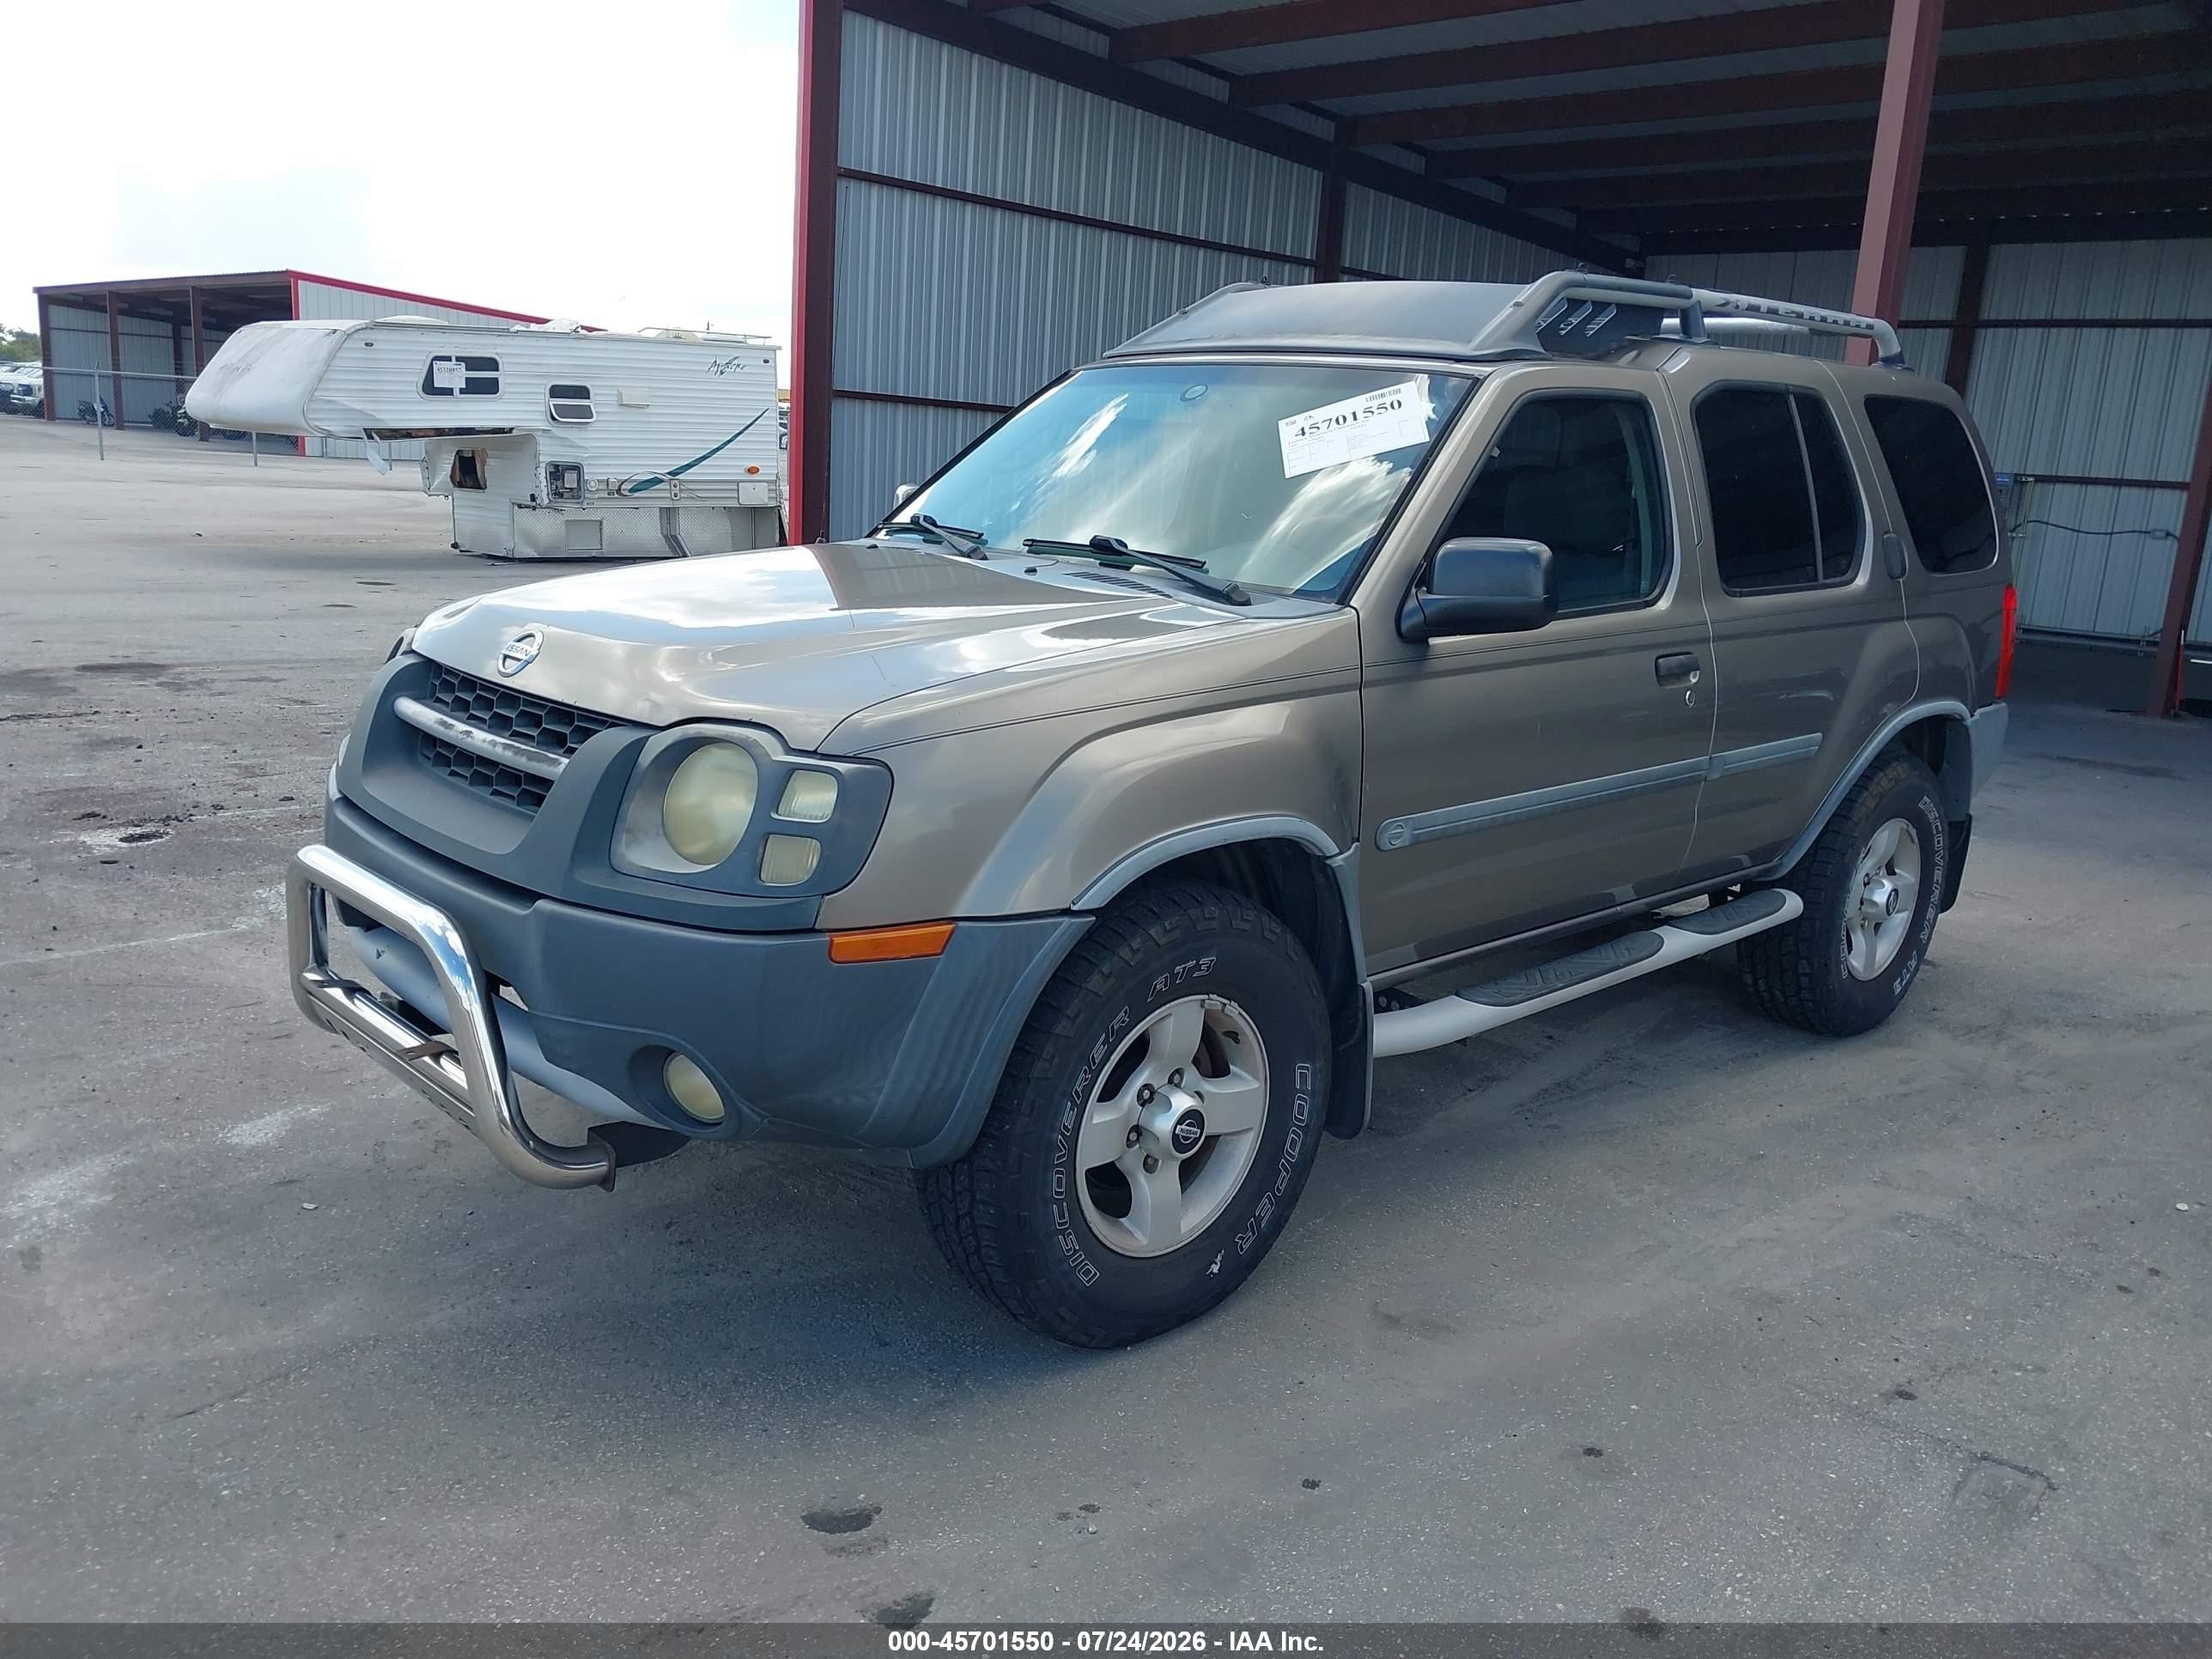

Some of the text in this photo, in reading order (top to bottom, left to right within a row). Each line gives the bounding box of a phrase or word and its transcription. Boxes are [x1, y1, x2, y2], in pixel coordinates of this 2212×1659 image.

[1294, 398, 1402, 437] 45701550
[1917, 795, 1946, 944] DISCOVERER
[1146, 956, 1218, 1003] AT3
[1051, 1005, 1131, 1288] DISCOVERER
[1180, 1127, 1199, 1136] NISSAN
[1234, 1062, 1313, 1256] COOPER
